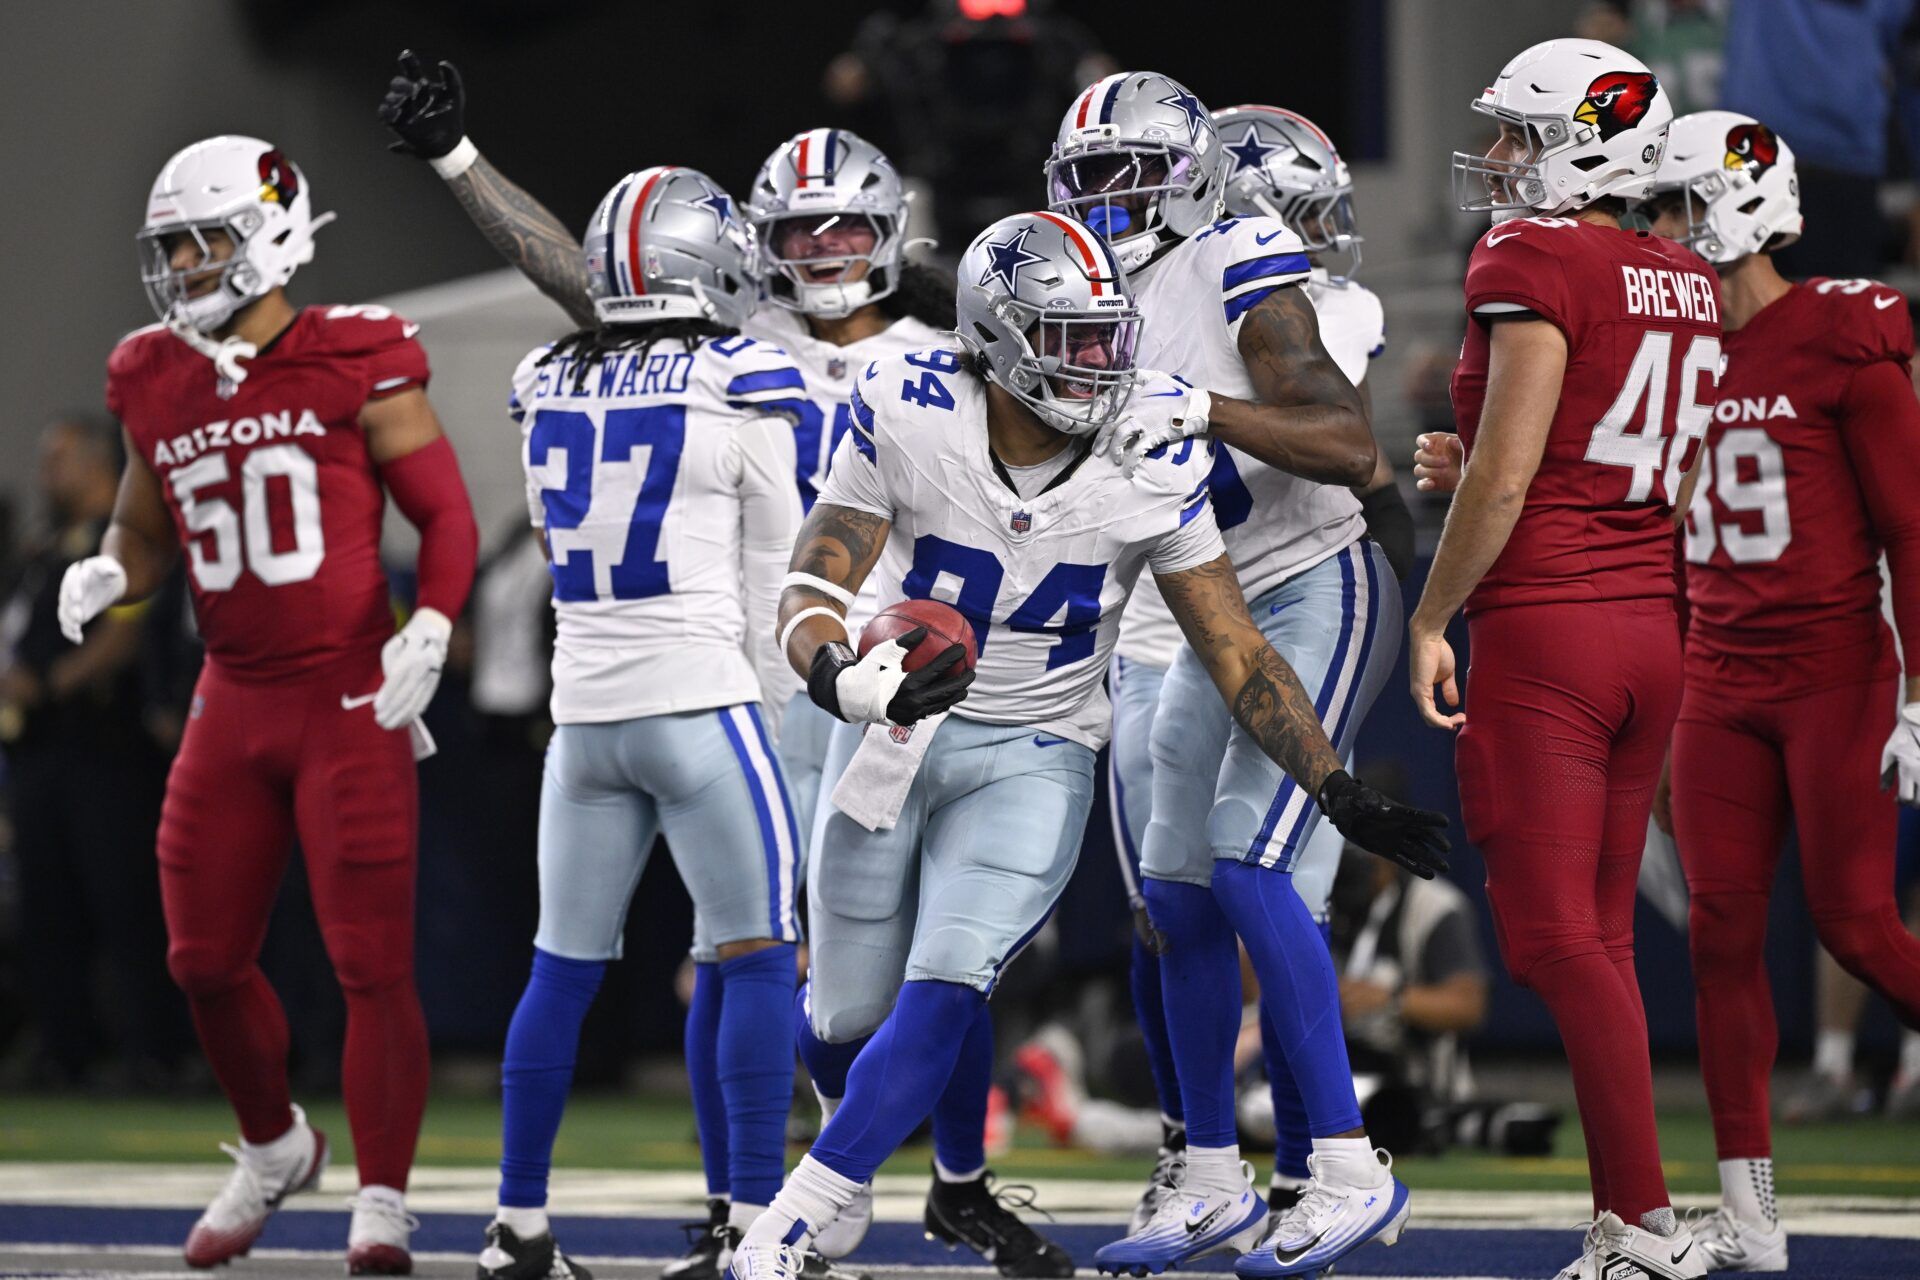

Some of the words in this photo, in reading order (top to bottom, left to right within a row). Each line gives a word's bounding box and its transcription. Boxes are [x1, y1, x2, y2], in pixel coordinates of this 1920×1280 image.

[1622, 265, 1718, 323] BREWER
[154, 408, 327, 466] ARIZONA
[901, 349, 961, 412] 94
[1583, 330, 1722, 507] 46
[169, 442, 326, 592] 50
[528, 404, 687, 602] 27
[902, 533, 1108, 672] 94
